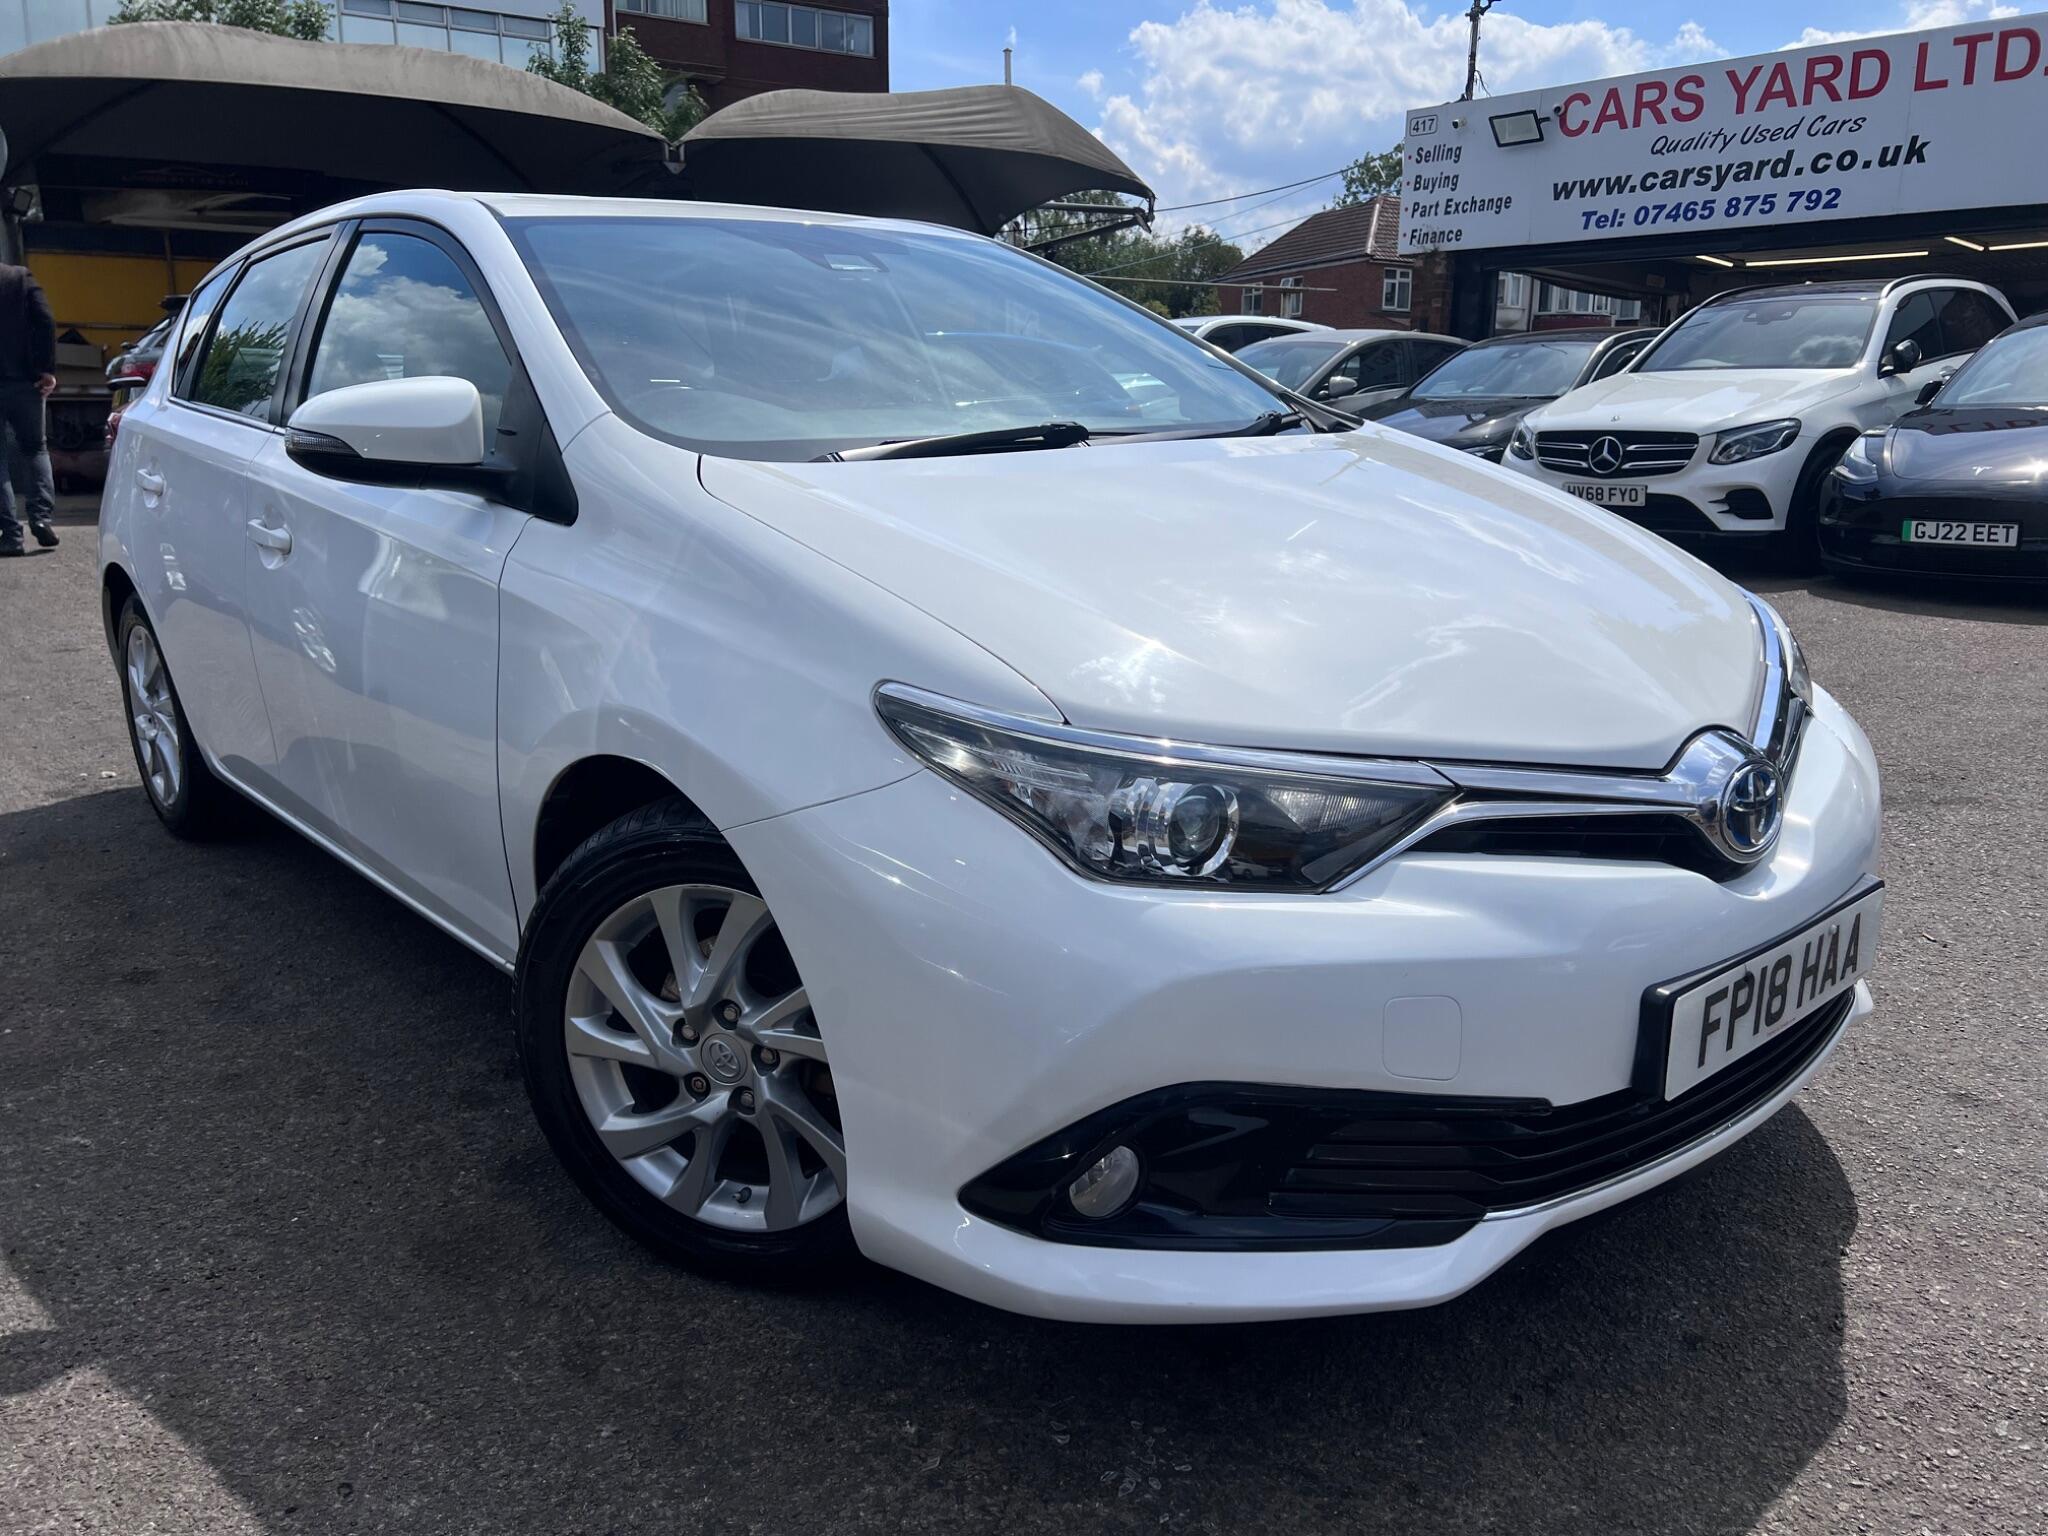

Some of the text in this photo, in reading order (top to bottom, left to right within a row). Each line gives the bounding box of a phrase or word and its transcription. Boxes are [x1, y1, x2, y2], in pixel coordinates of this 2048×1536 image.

[1559, 75, 1706, 138] CARS
[1725, 48, 1891, 115] YARD
[1412, 118, 1436, 133] 417
[1650, 114, 1867, 155] Quality Used Cars
[1415, 144, 1463, 164] Selling
[1553, 135, 1931, 201] www.carsyard.co.uk
[1413, 172, 1460, 194] Buying
[1411, 195, 1513, 219] Part Exchange
[1581, 187, 1841, 230] Tel: 07465 875 792
[1409, 228, 1463, 246] Finance
[1914, 522, 2015, 543] GJ22 EET
[1698, 912, 1861, 1069] FP18 HAA
